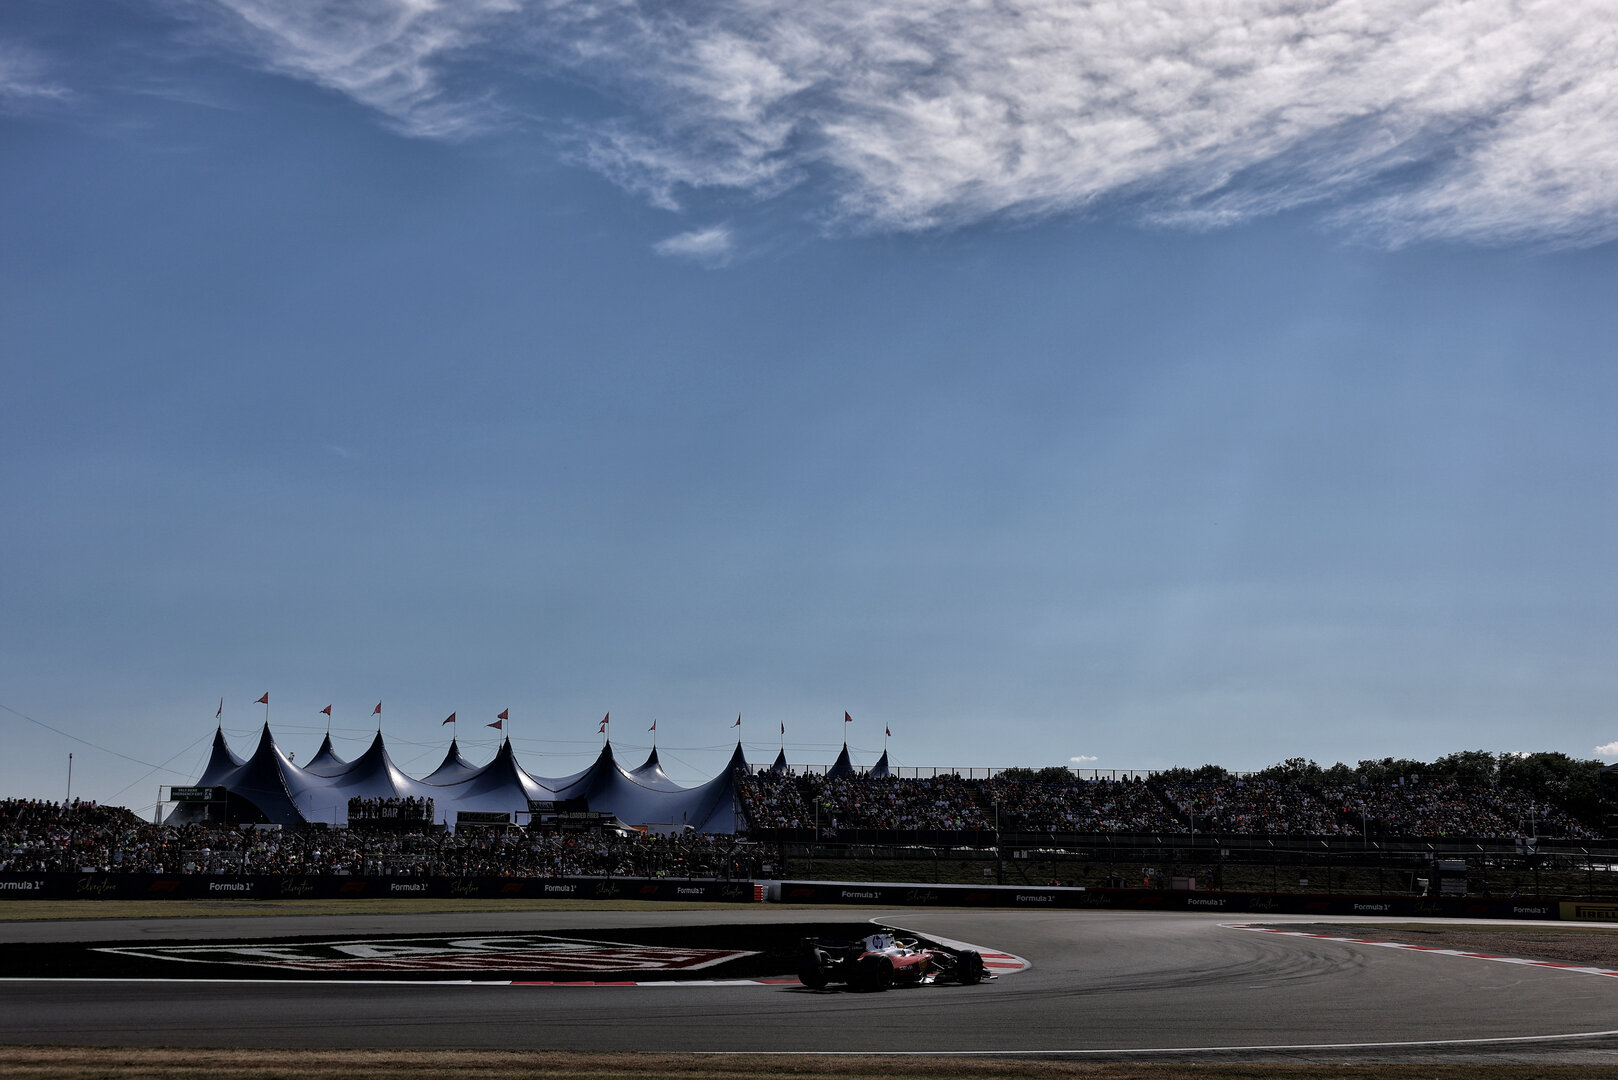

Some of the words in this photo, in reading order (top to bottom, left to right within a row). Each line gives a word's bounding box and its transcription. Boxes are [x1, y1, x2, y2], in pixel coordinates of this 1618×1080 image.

[382, 807, 398, 818] BAR
[0, 881, 32, 890] ormula
[209, 882, 244, 891] Formula
[390, 883, 420, 891] Formula
[544, 884, 570, 892] Formula
[677, 886, 699, 894] Formula
[841, 890, 873, 898] Formula
[1187, 898, 1218, 906] Formula
[1353, 903, 1383, 911] Formula
[1575, 905, 1618, 919] PIRELL
[159, 939, 604, 960] TAG
